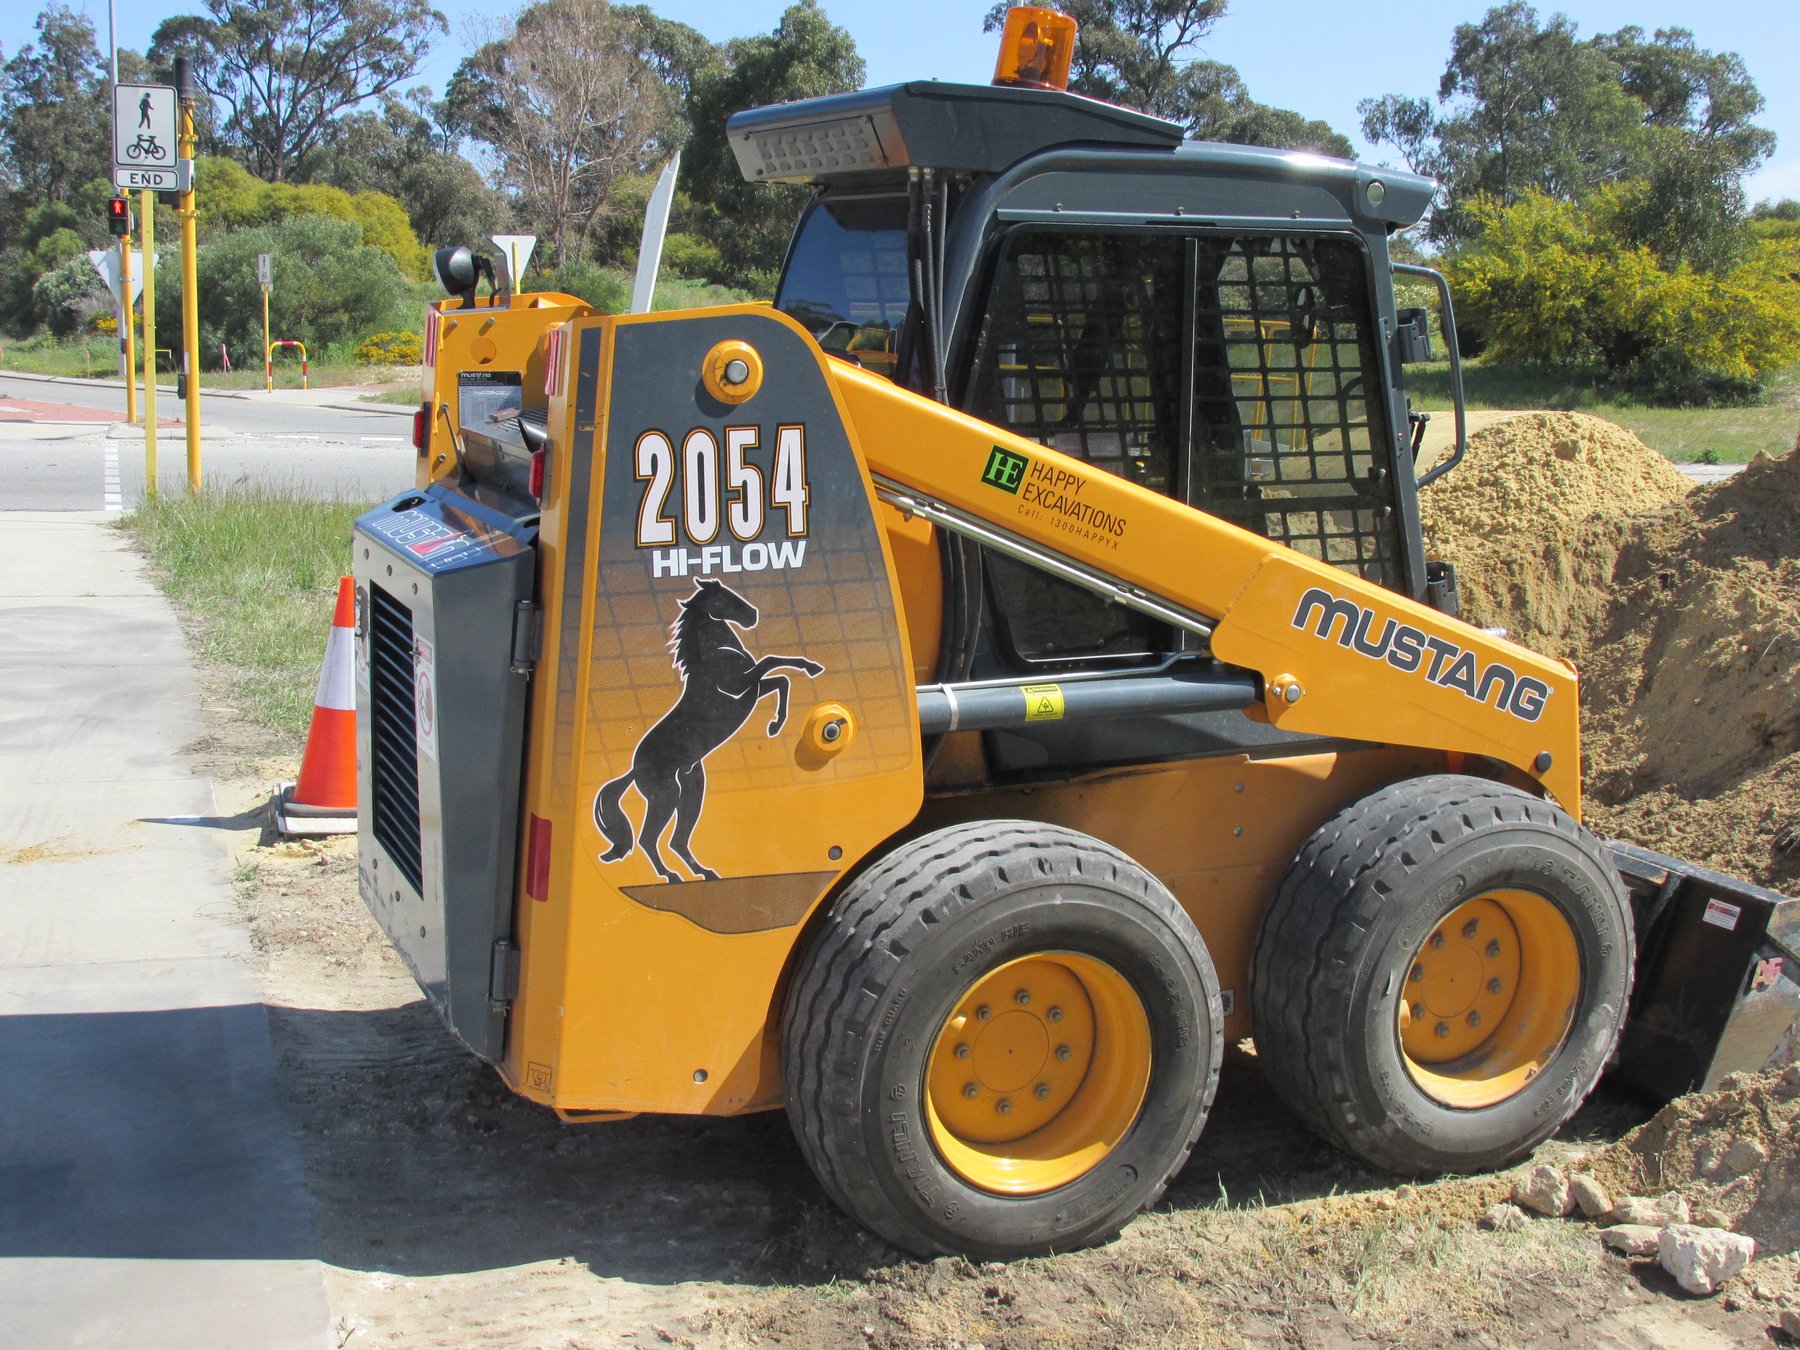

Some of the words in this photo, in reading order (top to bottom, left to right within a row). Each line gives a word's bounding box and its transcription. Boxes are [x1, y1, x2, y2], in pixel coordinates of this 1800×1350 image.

[130, 173, 163, 185] END
[633, 422, 812, 550] 2054
[1030, 461, 1087, 496] HAPPY
[1022, 482, 1127, 537] EXCAVATIONS
[1050, 517, 1119, 550] 1300HAPPYX
[652, 540, 808, 578] HI-FLOW
[1291, 587, 1549, 722] MUSTANG
